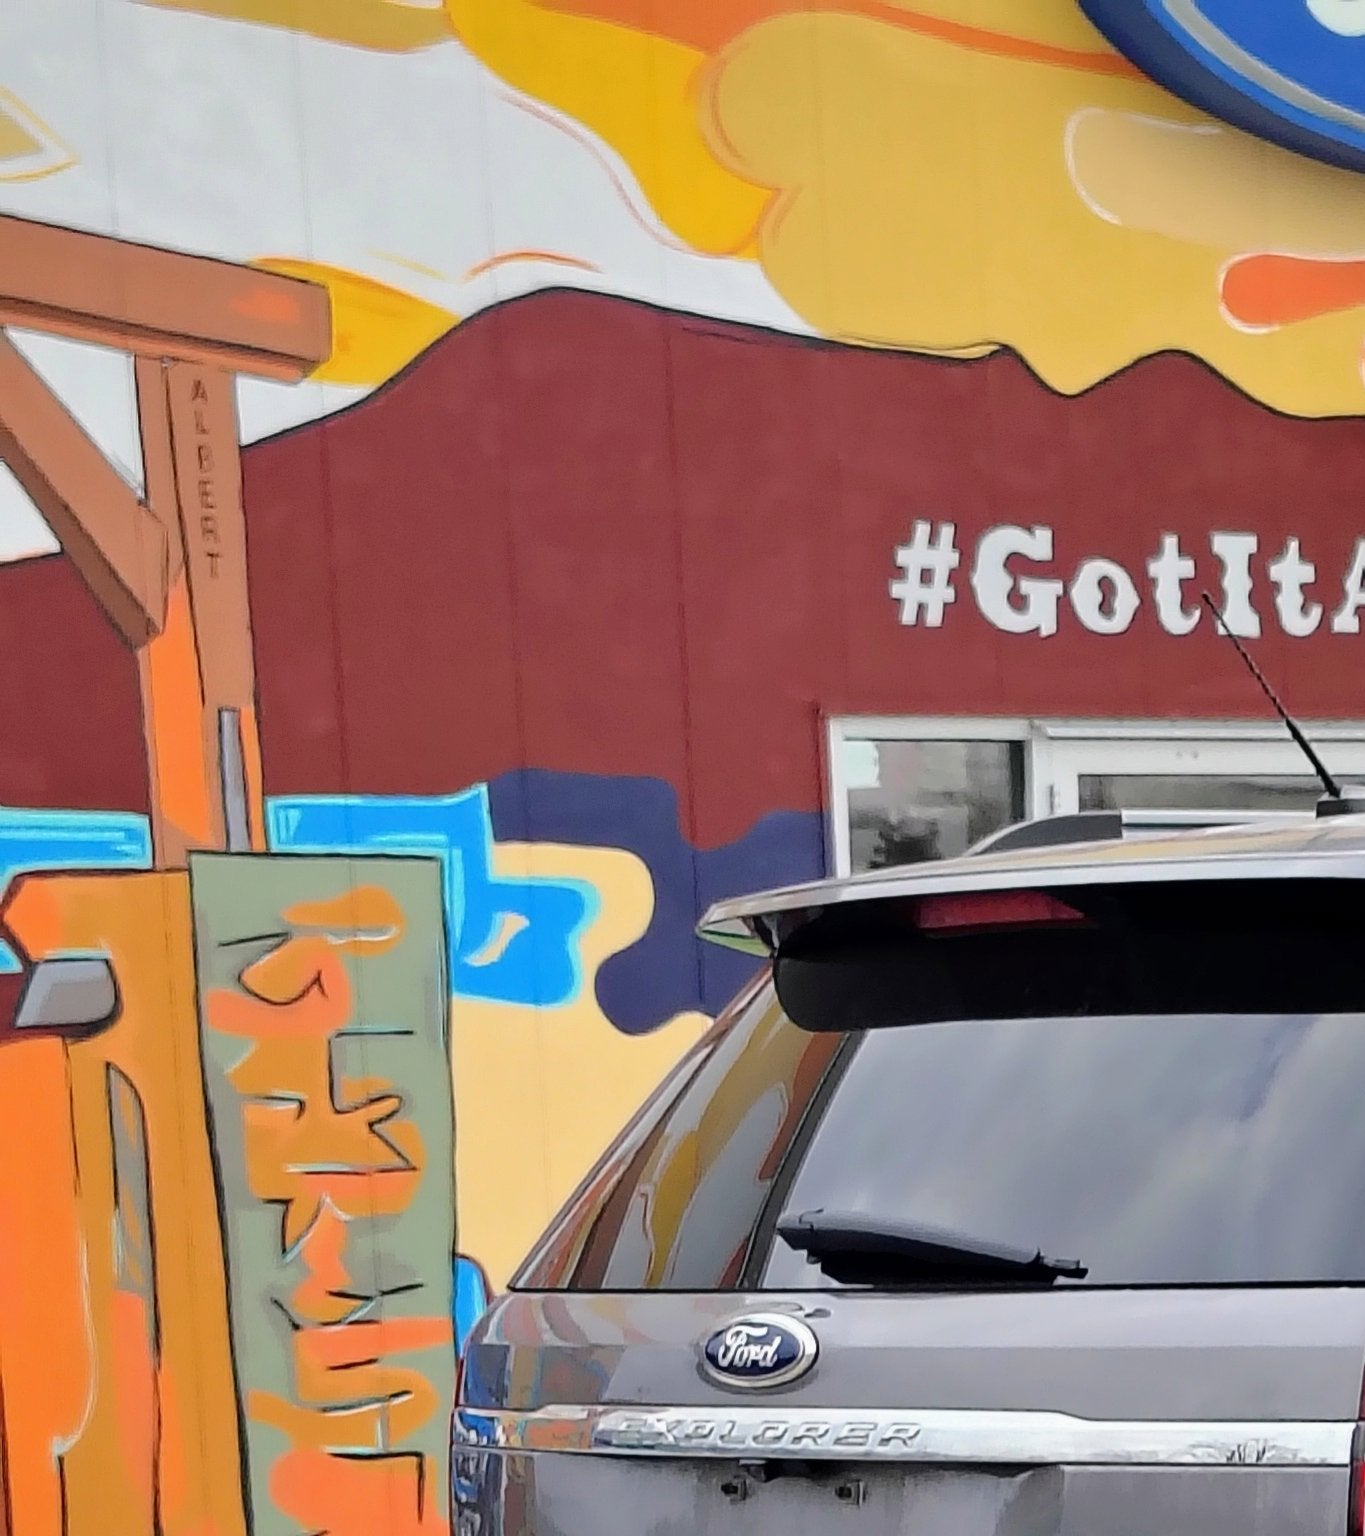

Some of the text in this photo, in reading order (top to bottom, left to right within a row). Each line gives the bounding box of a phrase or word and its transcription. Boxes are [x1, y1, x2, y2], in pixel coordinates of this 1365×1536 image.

[191, 379, 222, 580] ALBERT
[717, 1324, 782, 1369] Ford
[619, 1417, 922, 1448] EXPLORER
